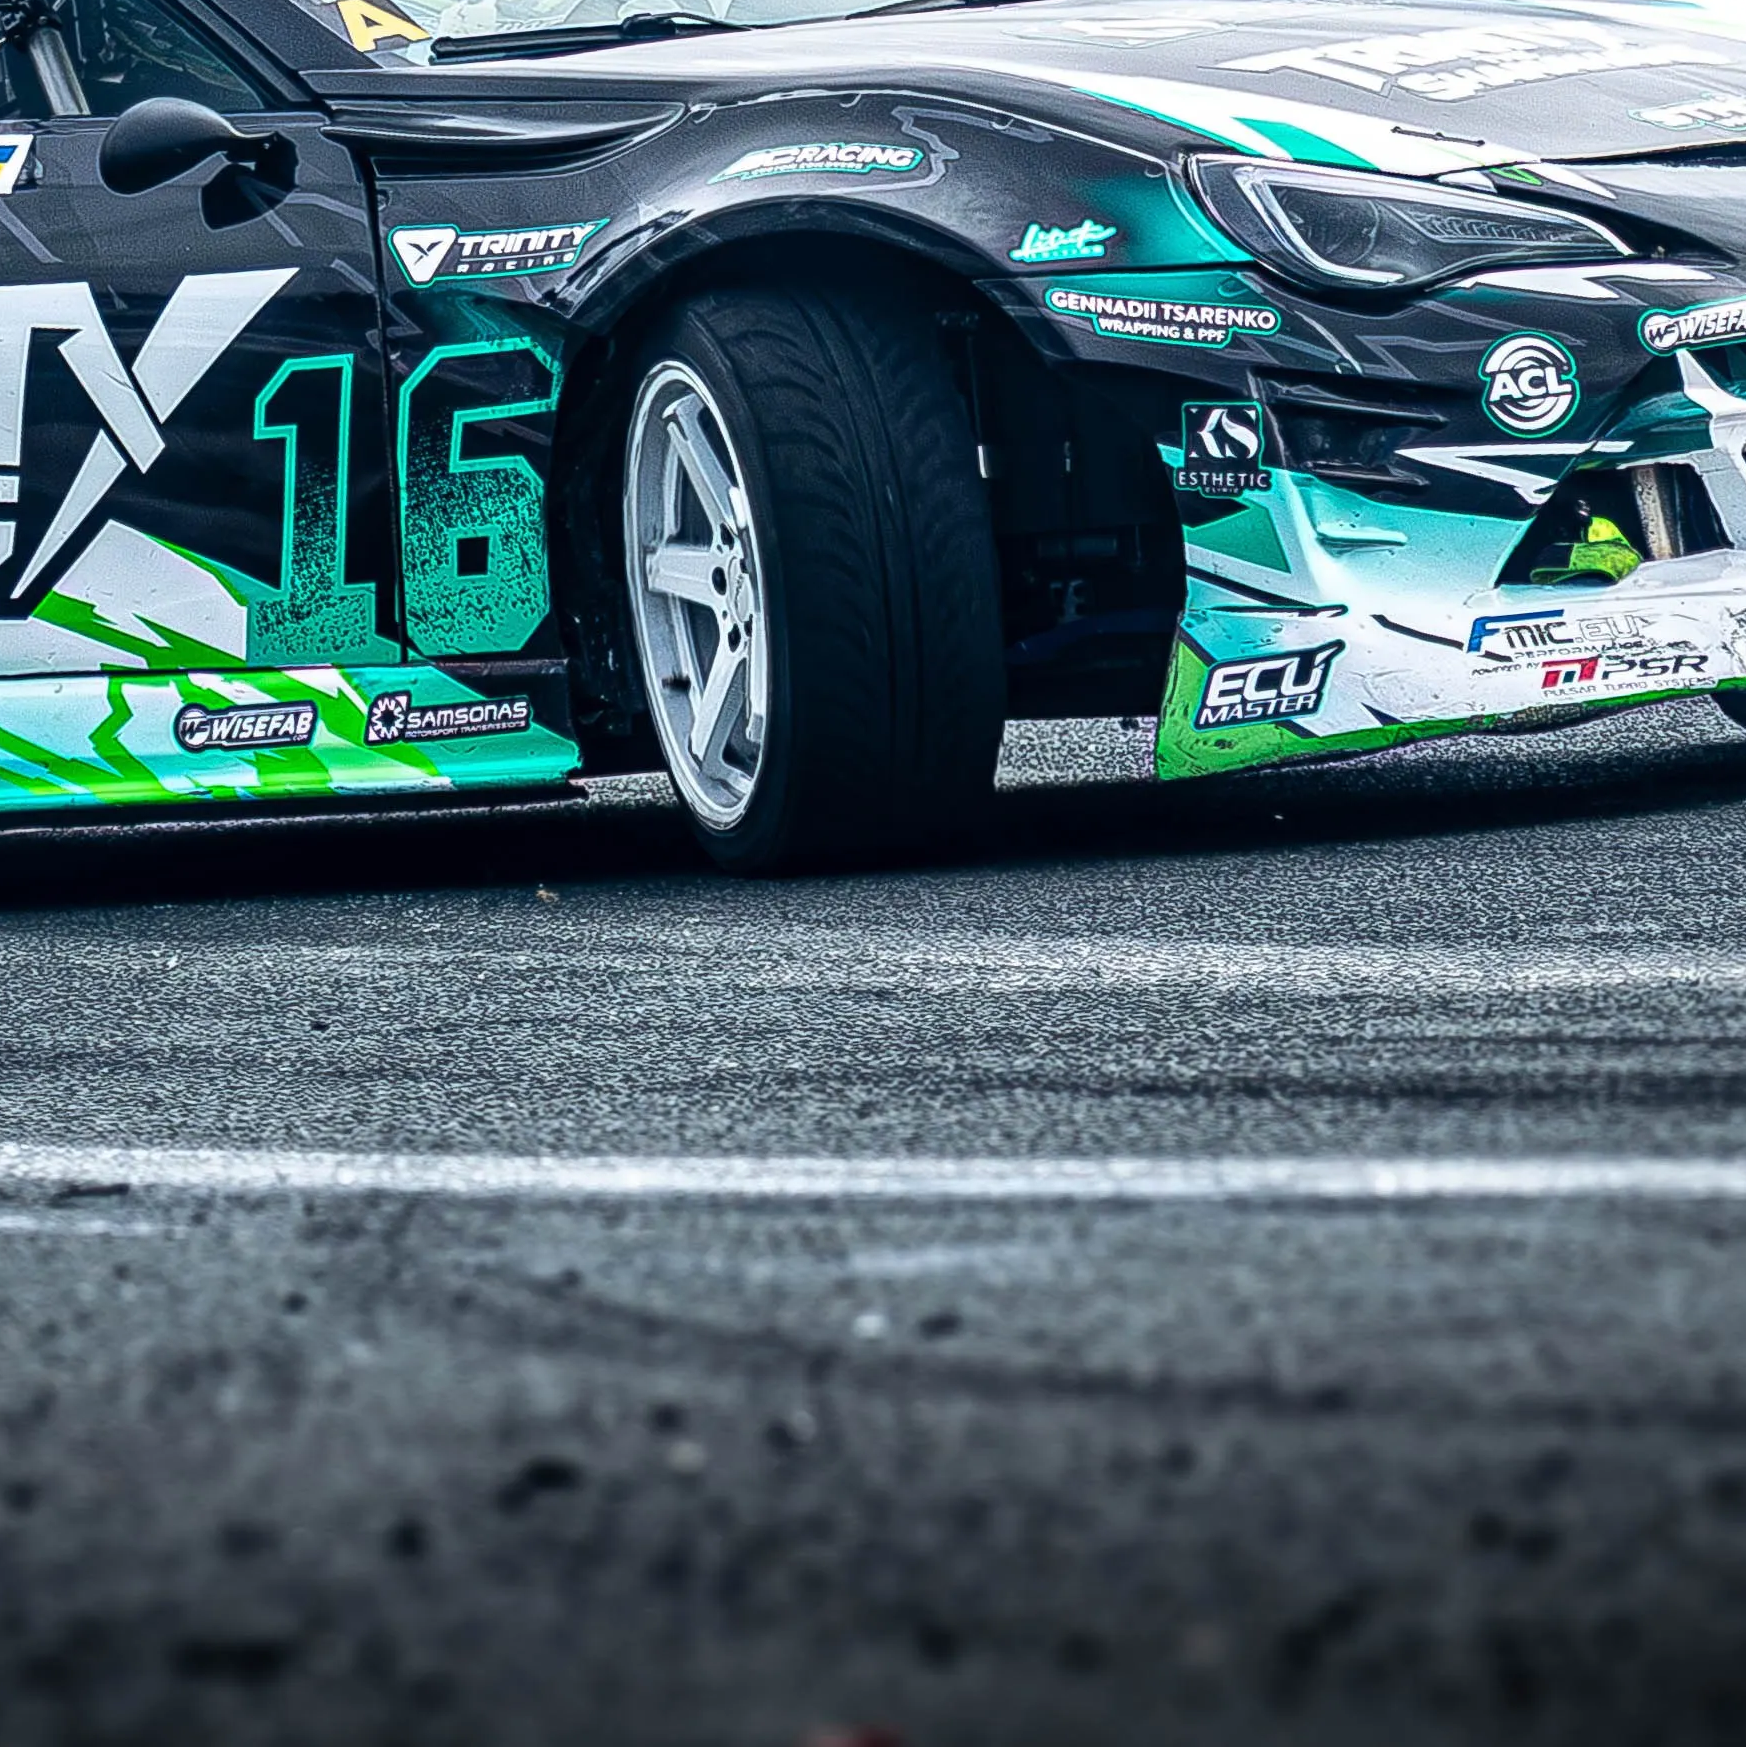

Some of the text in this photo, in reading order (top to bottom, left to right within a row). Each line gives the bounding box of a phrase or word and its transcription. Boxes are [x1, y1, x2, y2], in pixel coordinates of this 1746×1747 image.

[457, 224, 597, 256] TRINITY
[1051, 291, 1276, 330] GENNADII TSARENKO
[1098, 317, 1226, 342] WRAPPING & PPF
[1489, 366, 1572, 402] ACL
[1178, 471, 1268, 488] ESTHETIC
[253, 336, 562, 665] 16
[1205, 645, 1339, 707] ECU
[1600, 654, 1710, 681] PSR
[1543, 684, 1597, 698] PULSAR
[1653, 675, 1717, 688] SYSTEMS
[404, 700, 528, 730] SAMSONAS
[1199, 693, 1318, 725] MASTER
[211, 711, 314, 741] WISEFAB
